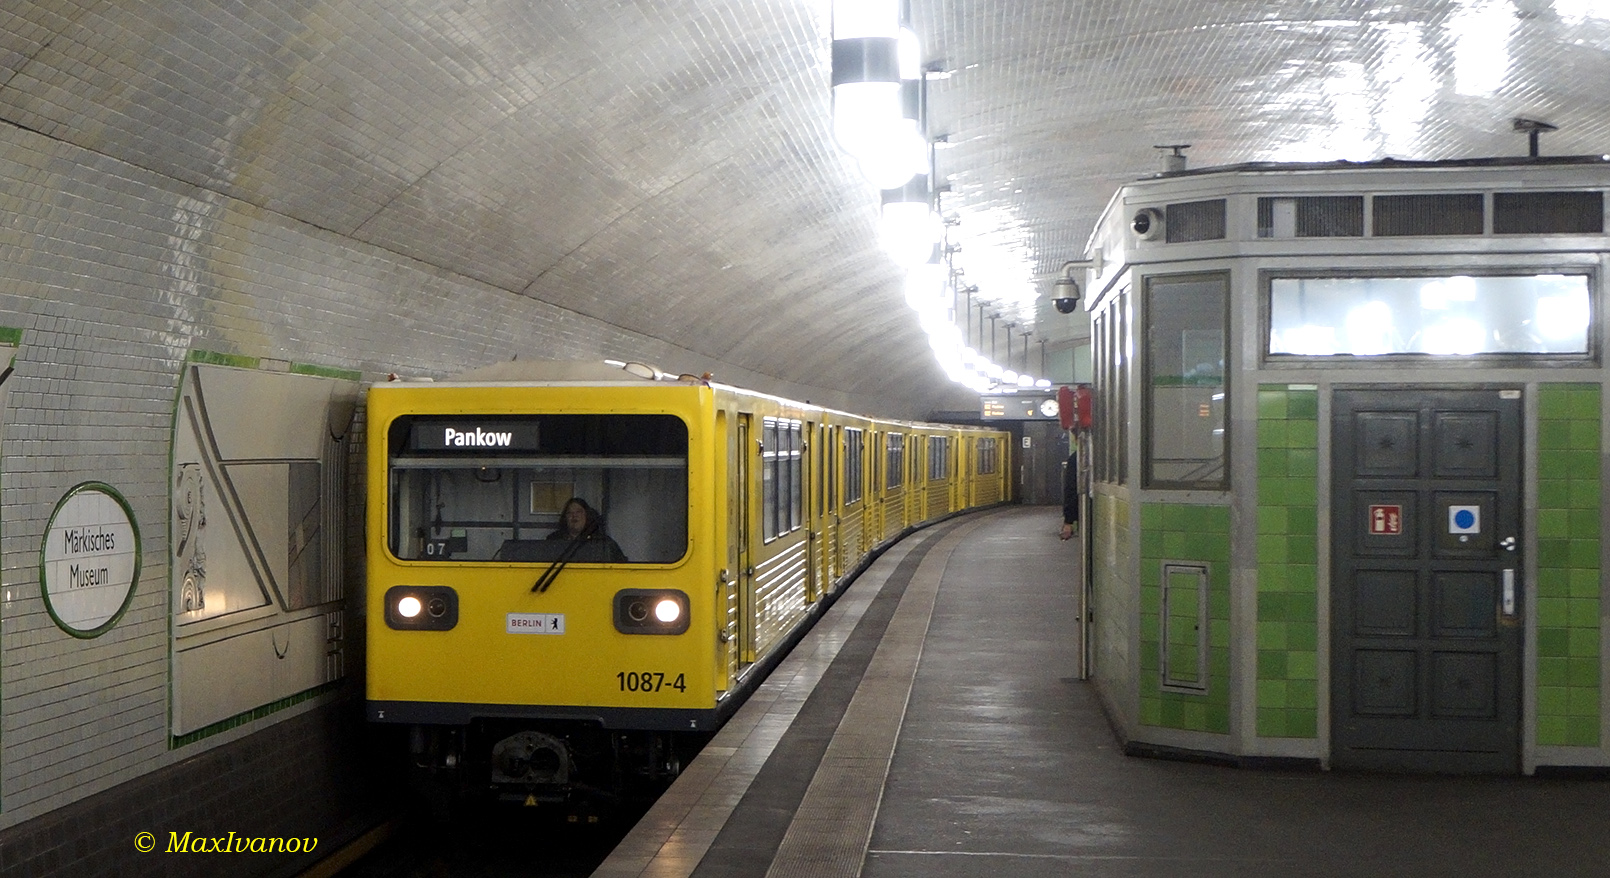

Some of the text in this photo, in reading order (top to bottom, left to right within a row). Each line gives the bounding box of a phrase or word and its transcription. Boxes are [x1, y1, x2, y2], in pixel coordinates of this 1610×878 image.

[445, 427, 512, 446] Pankow
[64, 526, 115, 554] Märkisches
[70, 564, 109, 588] Museum
[511, 619, 542, 627] BERLIN
[617, 672, 686, 693] 1087-4
